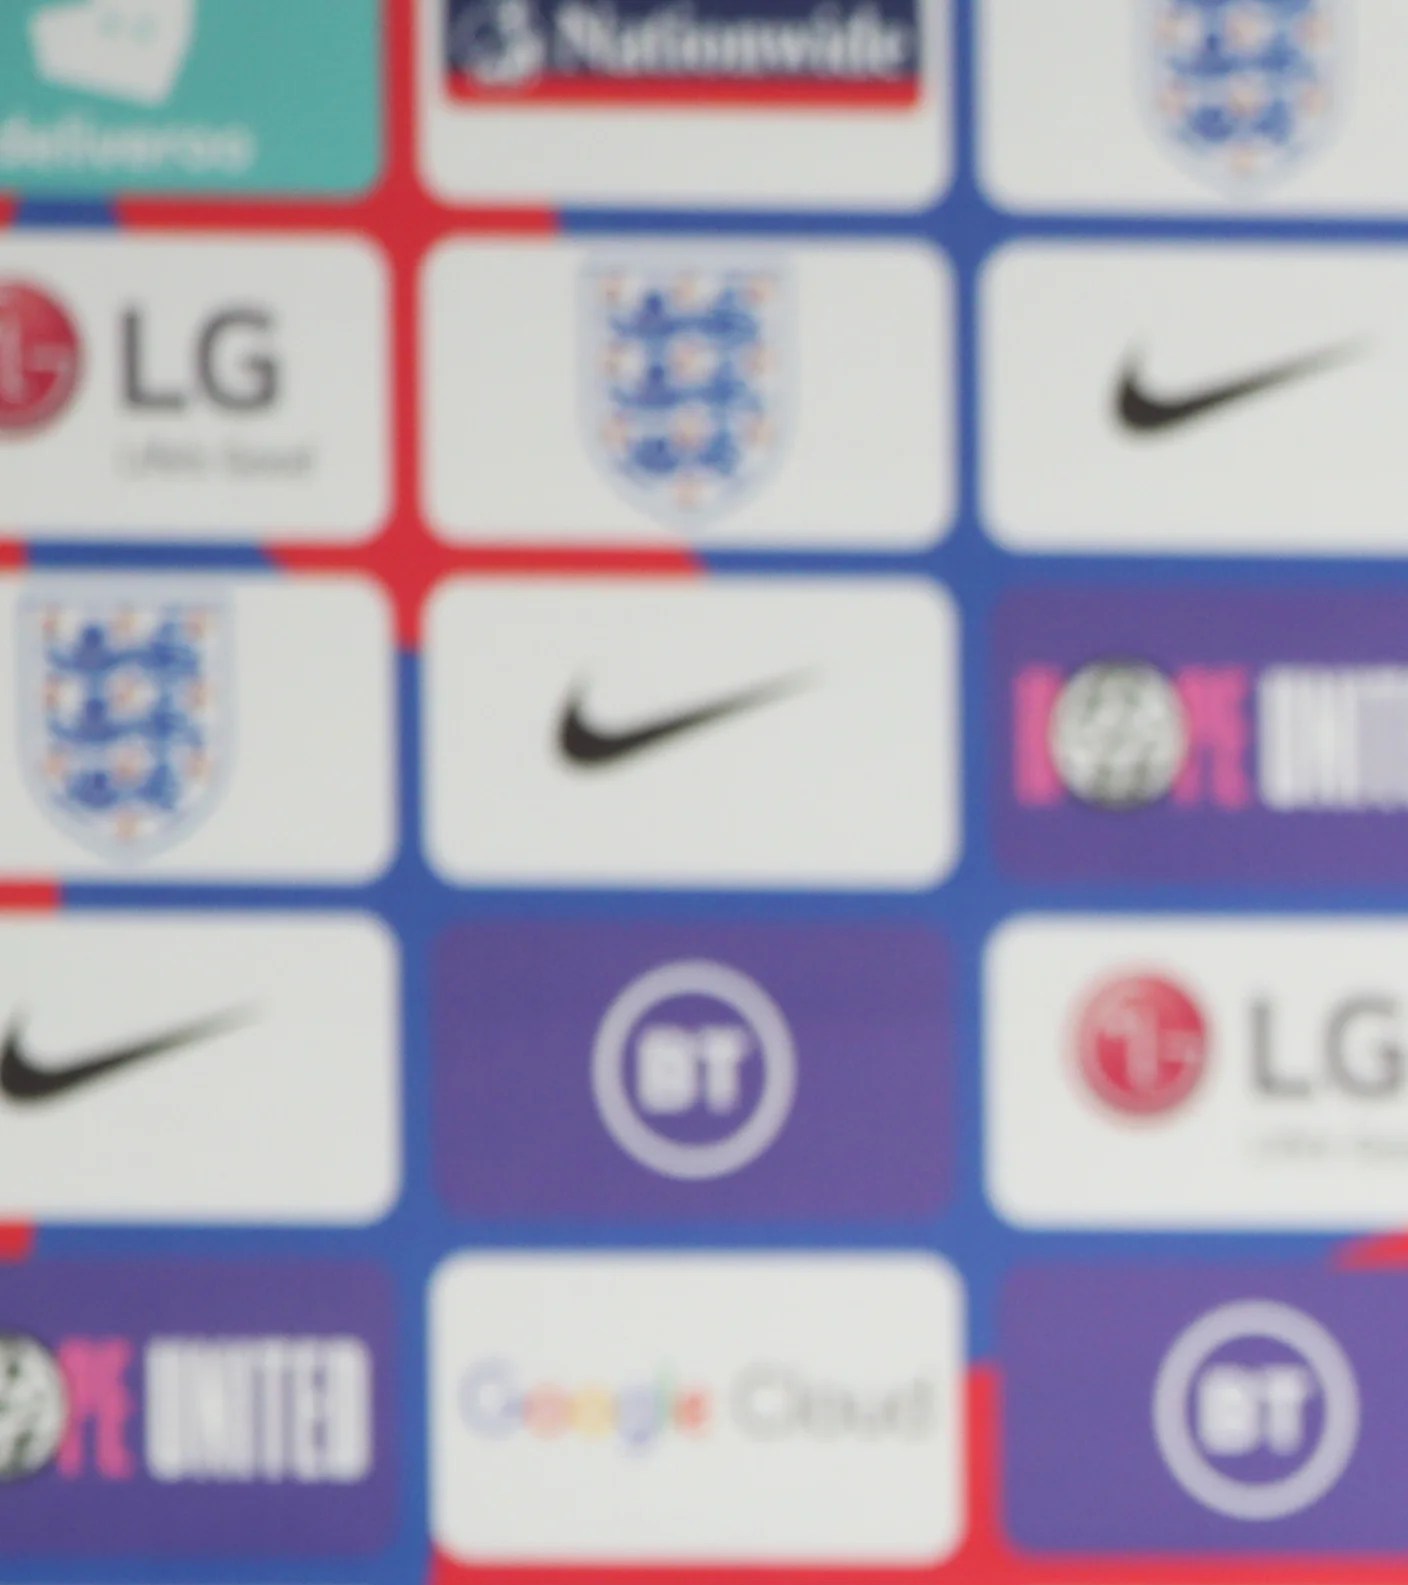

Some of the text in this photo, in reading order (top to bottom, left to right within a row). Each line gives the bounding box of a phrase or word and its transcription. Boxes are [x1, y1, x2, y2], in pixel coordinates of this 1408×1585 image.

[548, 4, 910, 80] Nationwide
[122, 308, 281, 411] LG
[634, 1024, 748, 1114] BT
[1250, 996, 1408, 1101] LG
[144, 1336, 371, 1482] UNITED
[458, 1356, 934, 1457] Google Cloud
[1196, 1363, 1314, 1457] BT
